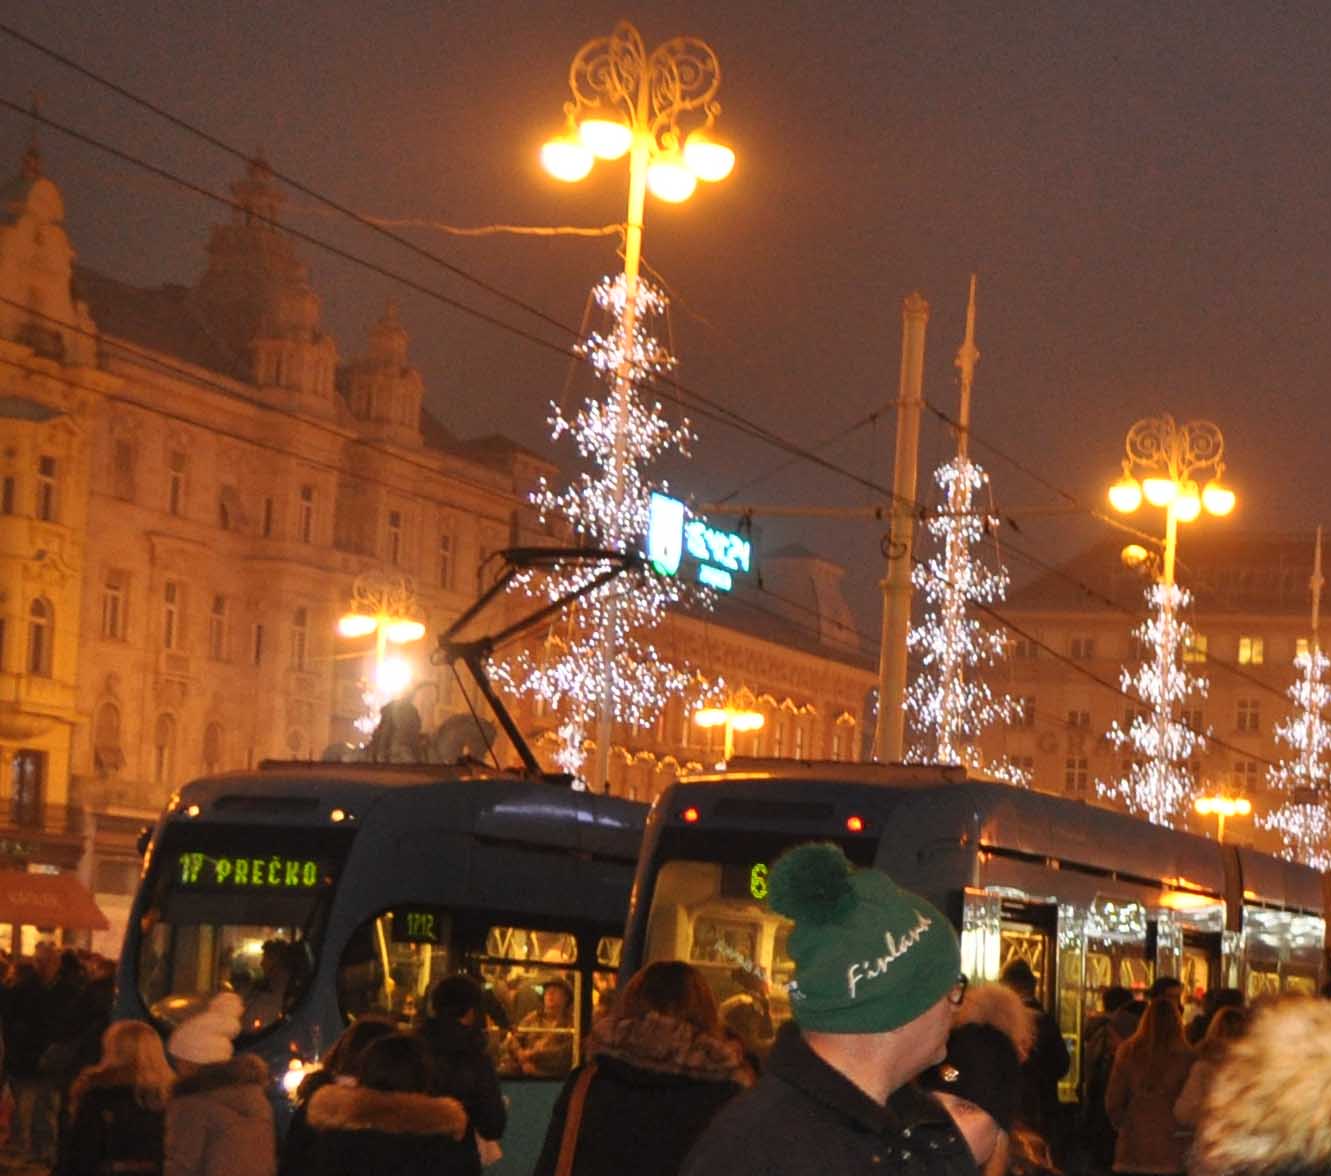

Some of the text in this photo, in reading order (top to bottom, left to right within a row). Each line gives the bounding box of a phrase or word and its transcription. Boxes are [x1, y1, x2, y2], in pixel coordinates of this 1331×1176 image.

[179, 852, 318, 887] 17 PREČKO
[750, 863, 769, 900] 6
[848, 907, 933, 999] Finland
